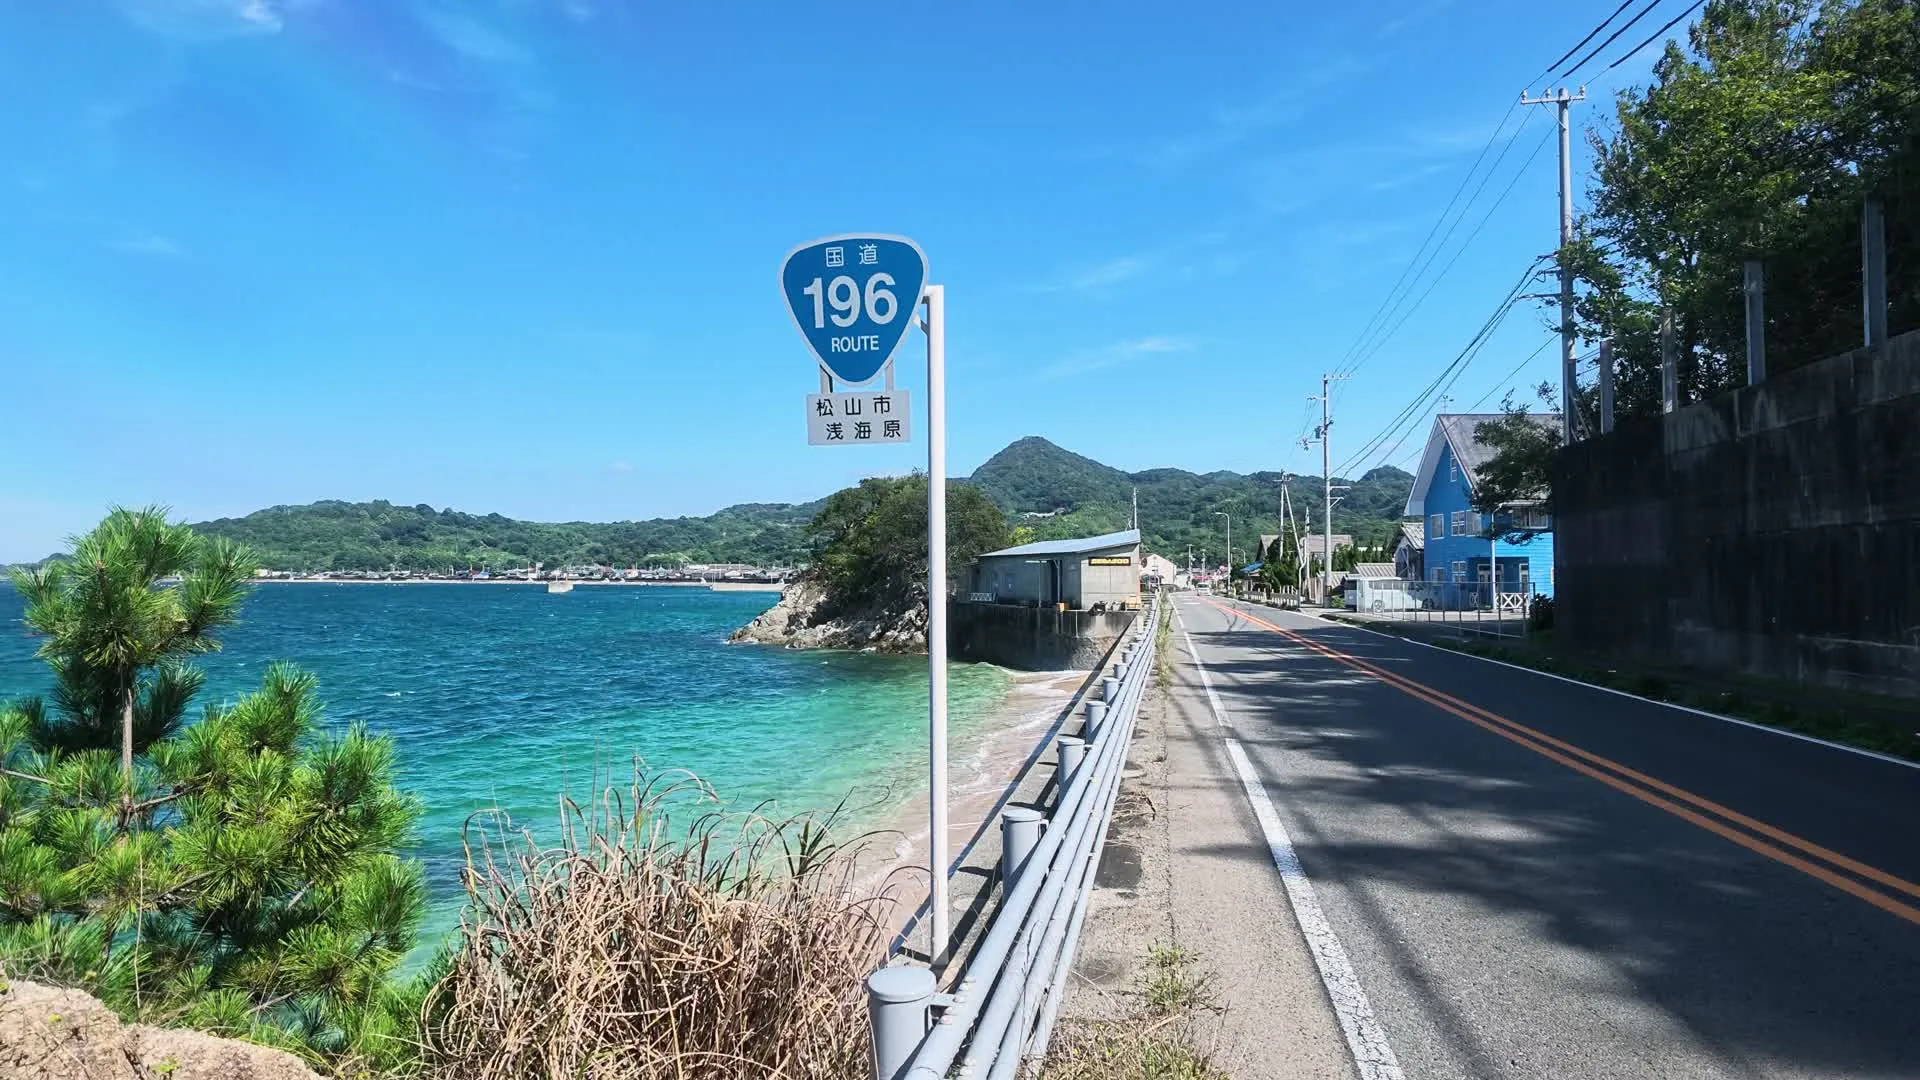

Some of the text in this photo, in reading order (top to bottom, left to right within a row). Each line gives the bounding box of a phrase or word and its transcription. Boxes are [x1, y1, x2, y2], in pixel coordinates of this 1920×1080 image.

[825, 244, 879, 267] 国道
[803, 272, 898, 329] 196
[831, 335, 879, 352] ROUTE
[816, 395, 891, 417] 松山市
[826, 419, 901, 440] 浅海原
